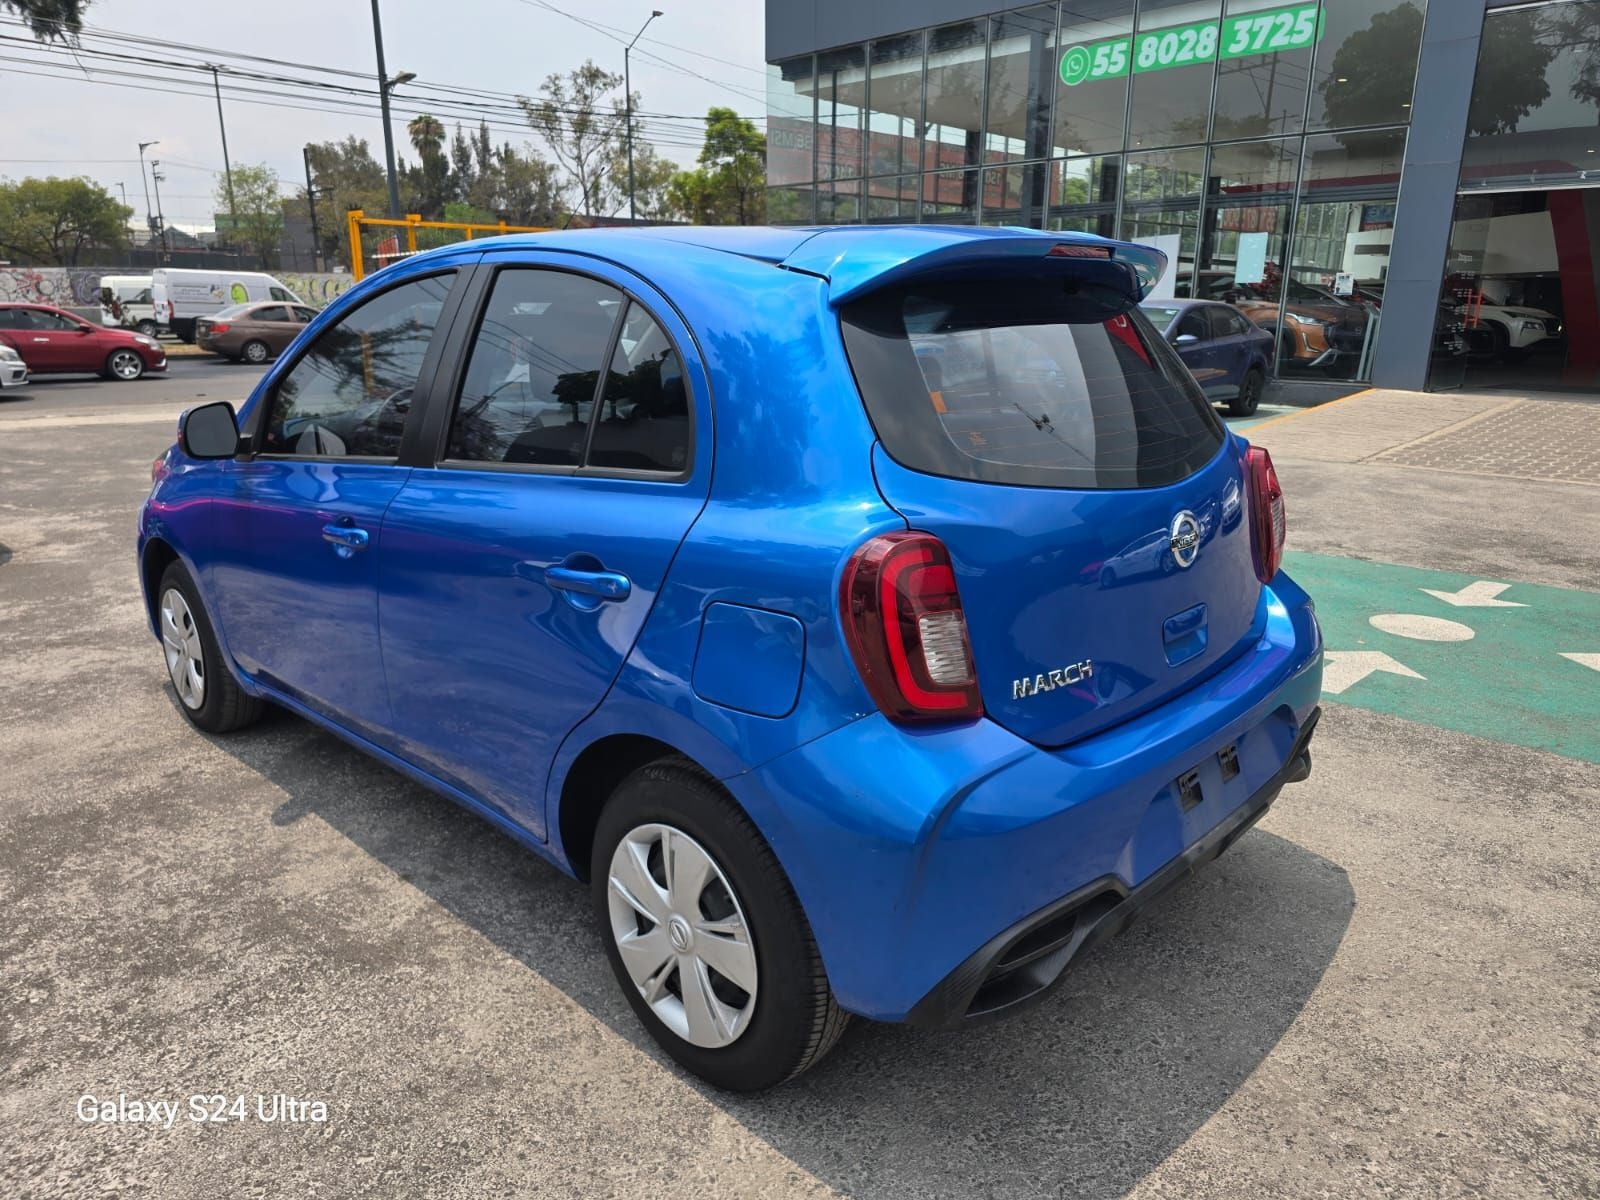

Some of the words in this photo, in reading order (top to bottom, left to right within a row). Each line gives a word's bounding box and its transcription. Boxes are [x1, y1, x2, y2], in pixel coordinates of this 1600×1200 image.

[1091, 41, 1129, 77] 55
[1137, 25, 1218, 69] 8028
[1228, 8, 1319, 54] 3725
[1013, 659, 1093, 700] MARCH
